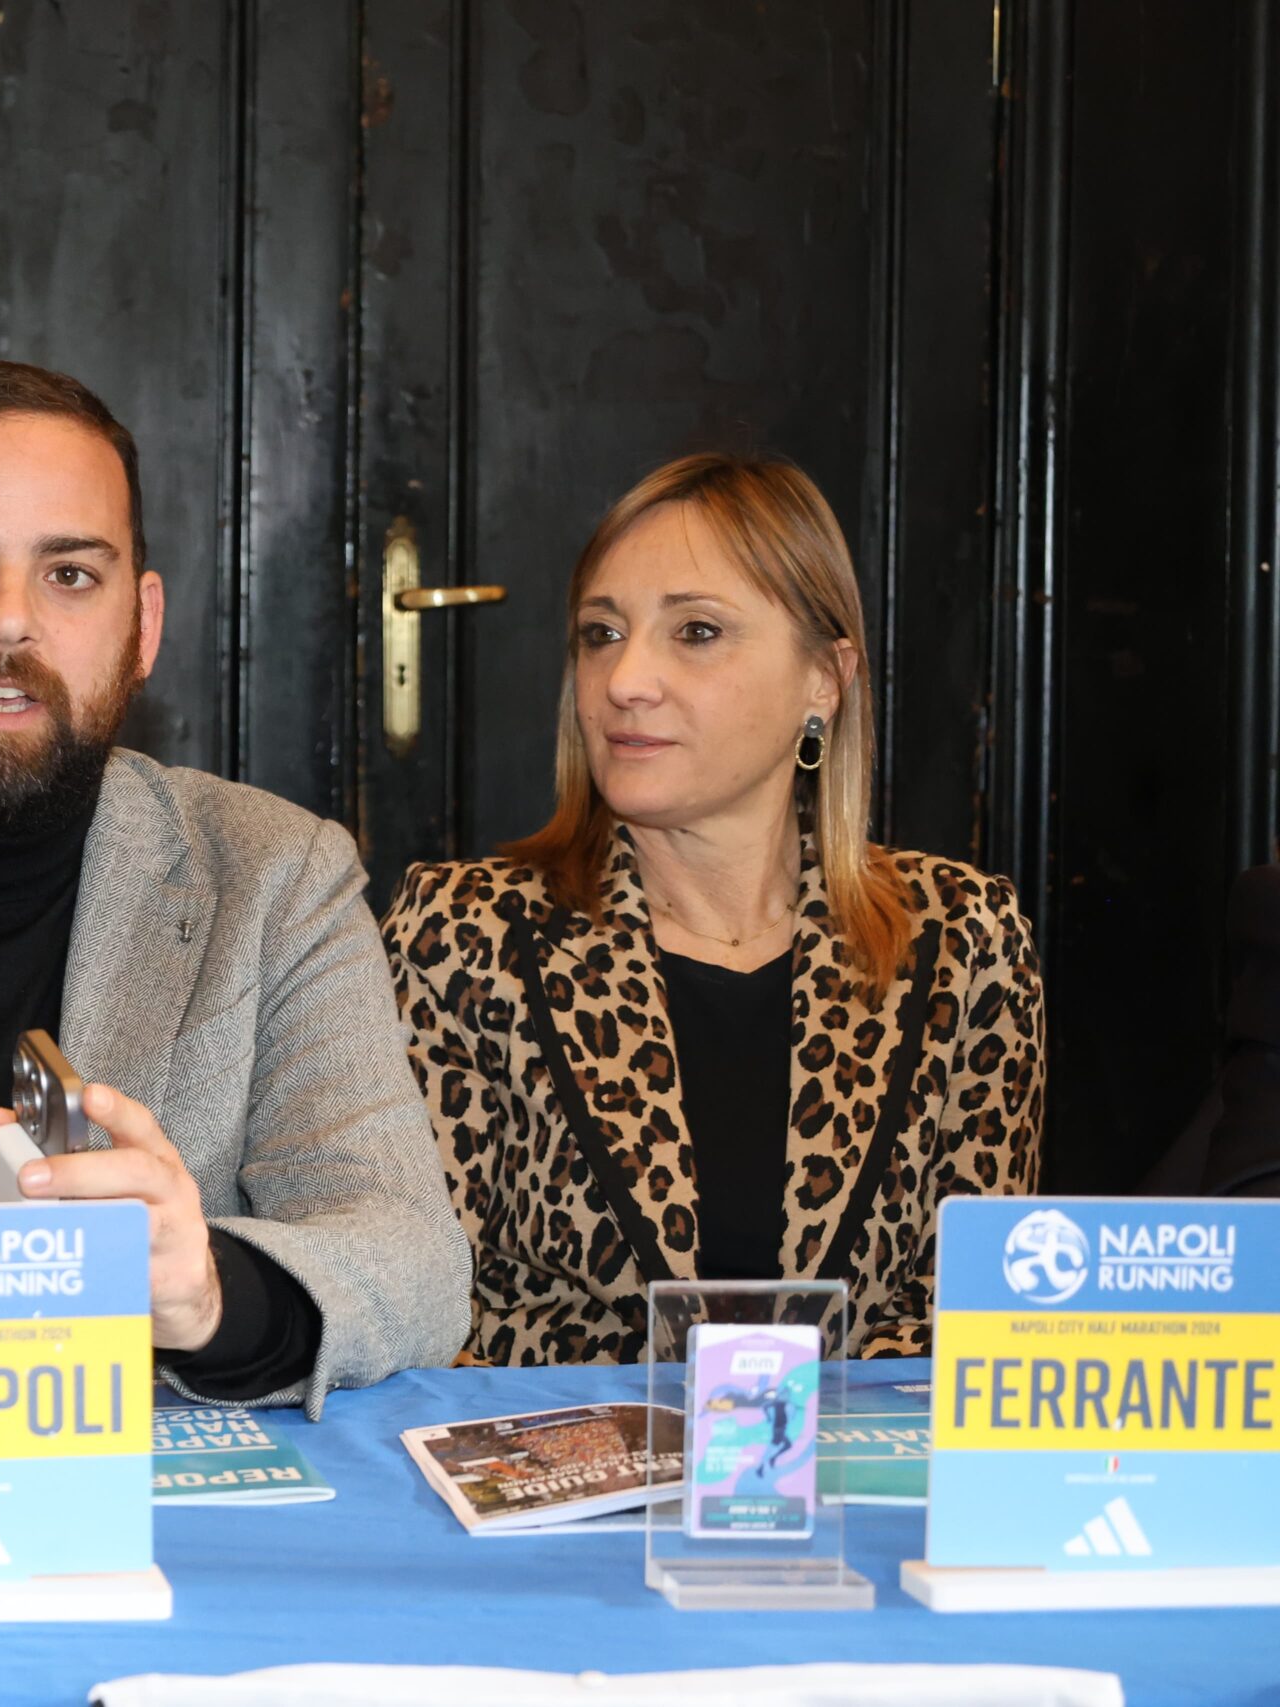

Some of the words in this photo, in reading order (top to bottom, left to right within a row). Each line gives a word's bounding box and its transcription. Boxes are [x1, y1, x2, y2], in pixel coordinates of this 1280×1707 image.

[1098, 1223, 1236, 1256] NAPOLI
[1098, 1265, 1234, 1292] RUNNING
[42, 1326, 72, 1341] 2024
[1010, 1320, 1054, 1334] NAPOLI
[1058, 1320, 1084, 1334] CITY
[1088, 1320, 1115, 1335] HALF
[1121, 1321, 1187, 1335] MARATHON
[1191, 1321, 1221, 1336] 2024
[738, 1357, 775, 1370] anm
[954, 1357, 1274, 1429] FERRANTE
[500, 1470, 609, 1501] GUIDE
